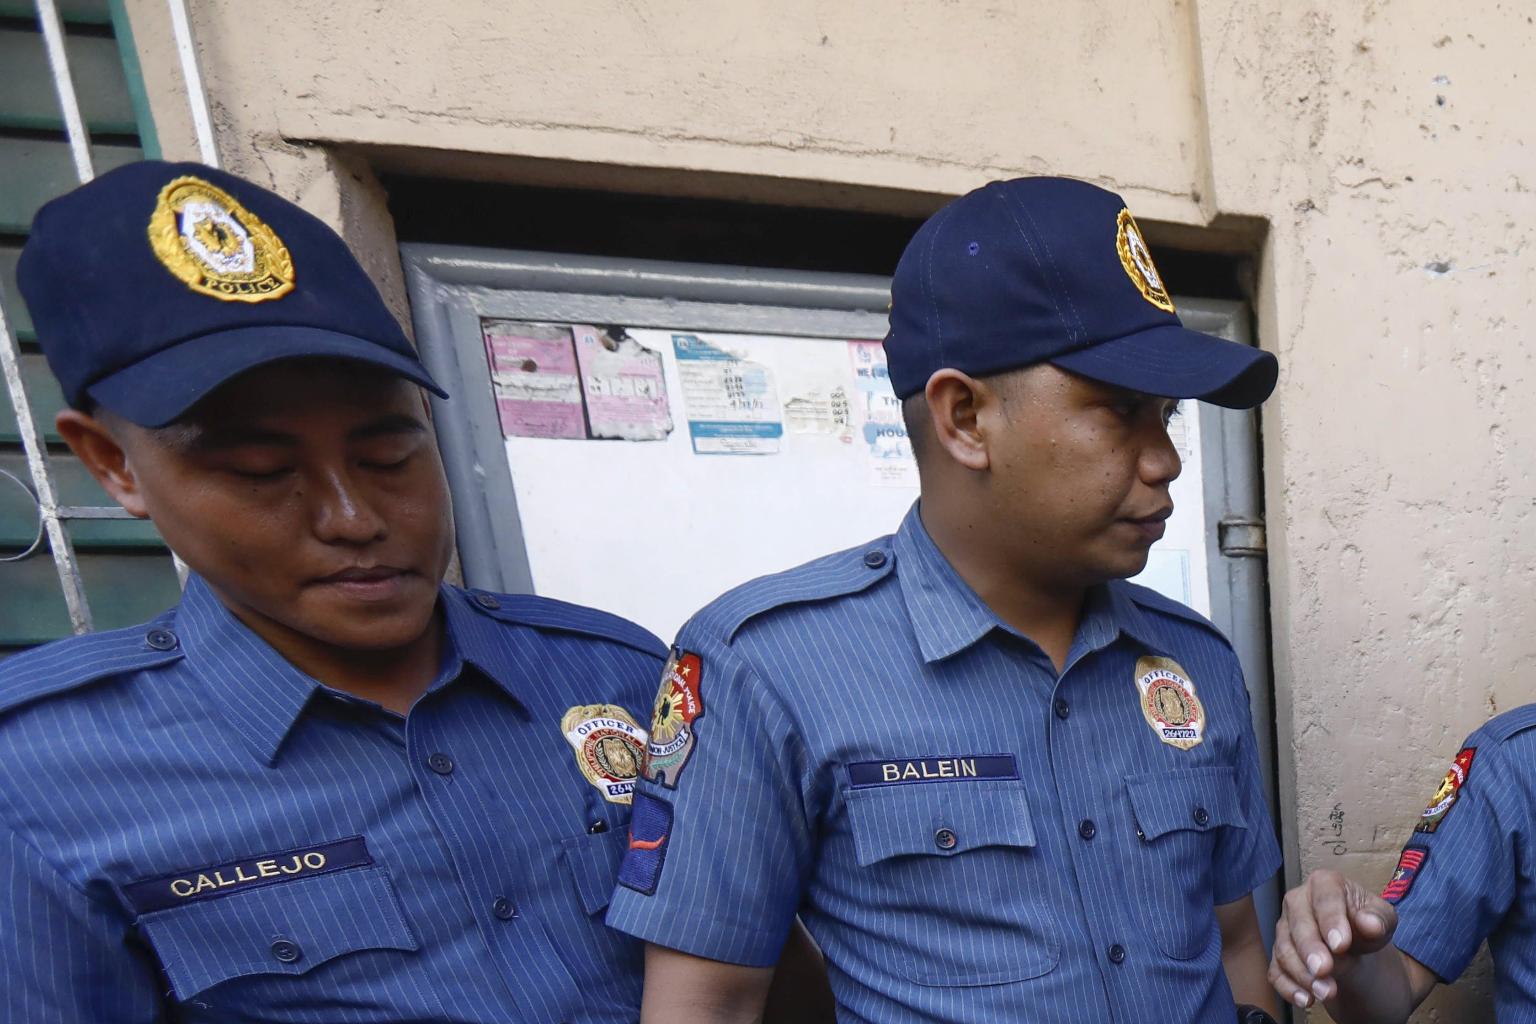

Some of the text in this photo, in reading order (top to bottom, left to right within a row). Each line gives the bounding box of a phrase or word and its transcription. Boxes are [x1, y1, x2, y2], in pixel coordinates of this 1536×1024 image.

[207, 277, 280, 294] POLICE
[1144, 670, 1185, 685] OFFICER
[578, 719, 634, 736] OFFICER
[882, 759, 978, 782] BALEIN
[170, 851, 326, 897] CALLEJO
